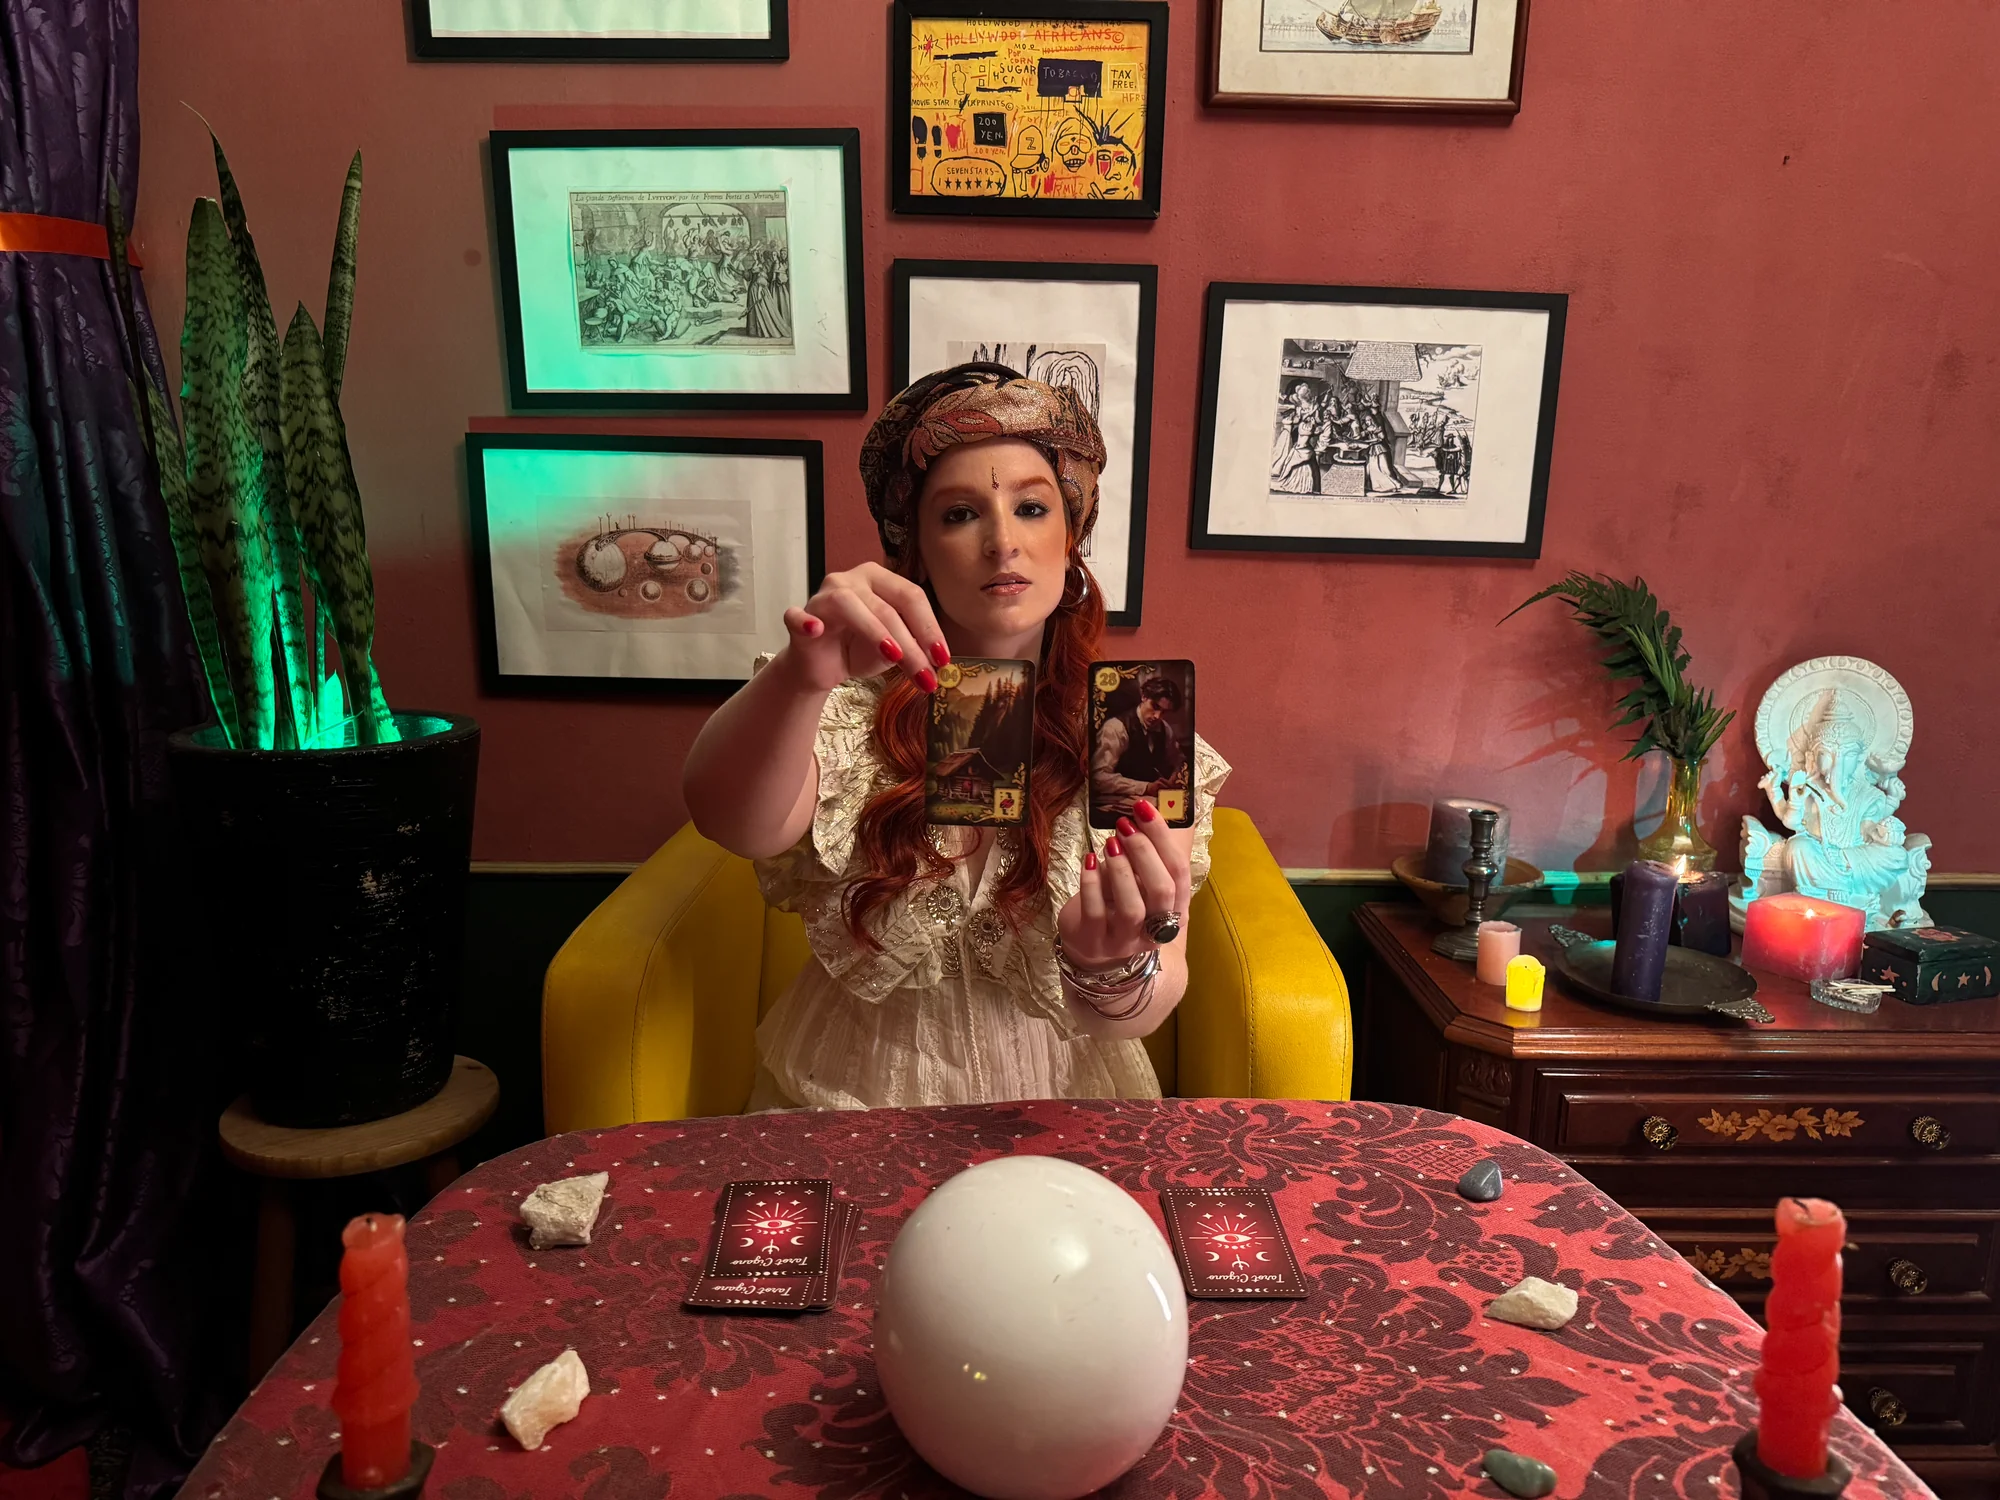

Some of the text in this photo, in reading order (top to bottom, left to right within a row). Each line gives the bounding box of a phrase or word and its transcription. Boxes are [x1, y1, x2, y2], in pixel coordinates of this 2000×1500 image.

[999, 63, 1037, 75] SUGAR
[1111, 69, 1132, 80] TAX
[933, 99, 950, 107] STAR
[978, 117, 997, 126] 200
[940, 669, 959, 683] 04
[1099, 673, 1118, 686] 28
[729, 1256, 808, 1267] Tarot Cigano
[1206, 1271, 1285, 1283] Tarot Cigano
[711, 1282, 792, 1296] Tarot Cigano
